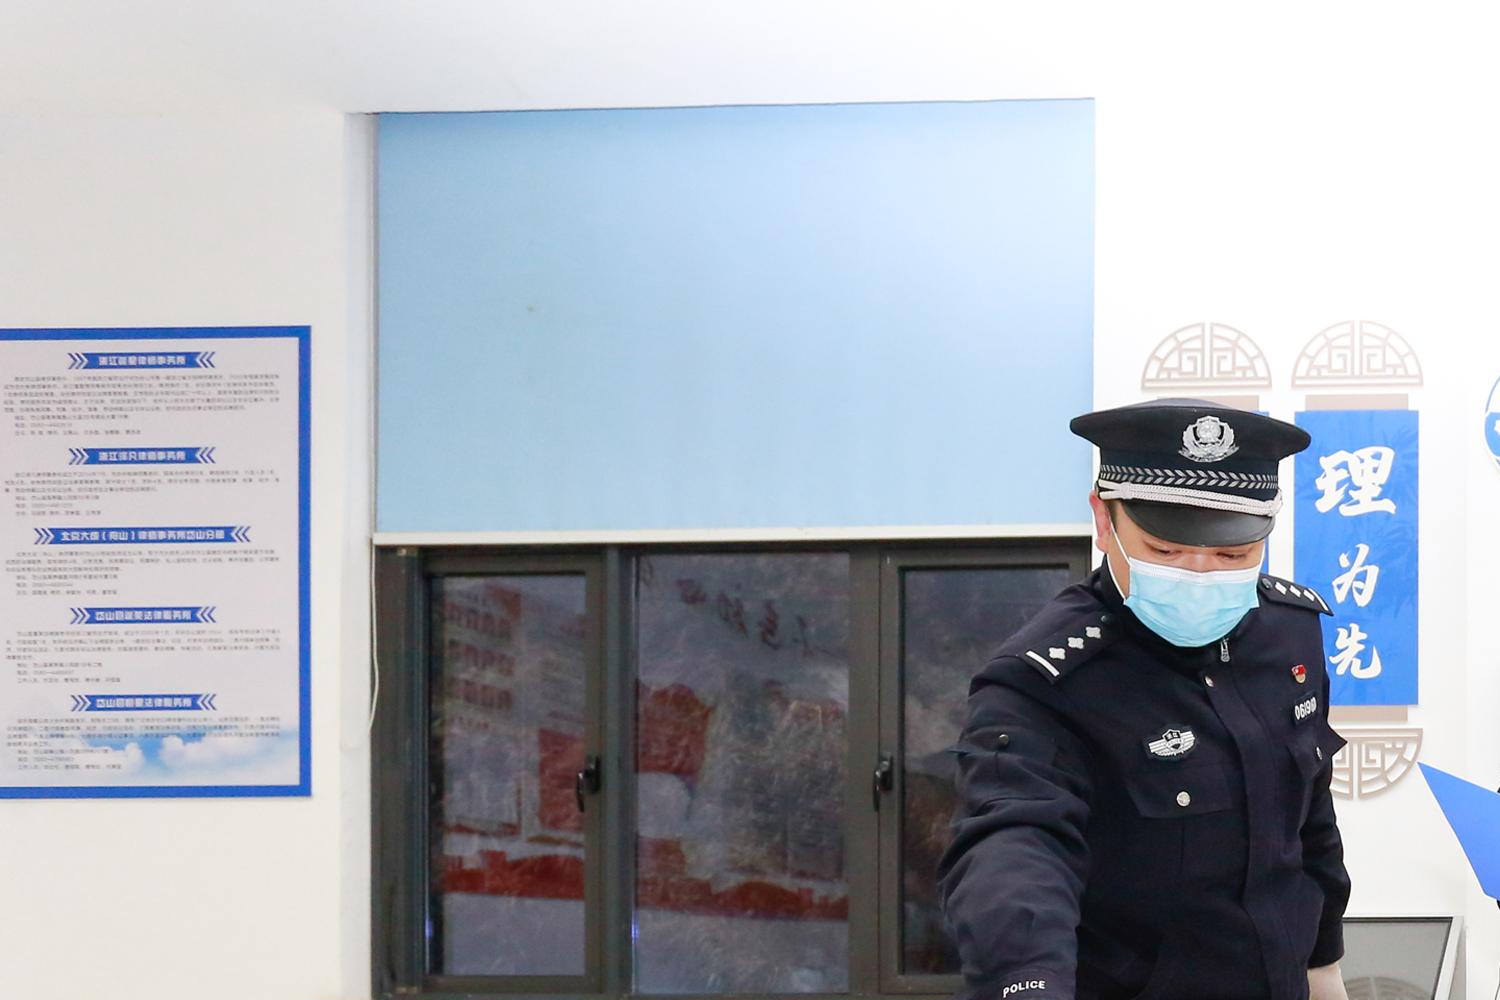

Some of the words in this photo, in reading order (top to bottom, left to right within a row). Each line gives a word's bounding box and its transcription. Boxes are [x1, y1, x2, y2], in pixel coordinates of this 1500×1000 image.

[1315, 446, 1397, 679] 理为先
[1002, 980, 1046, 998] POLICE
